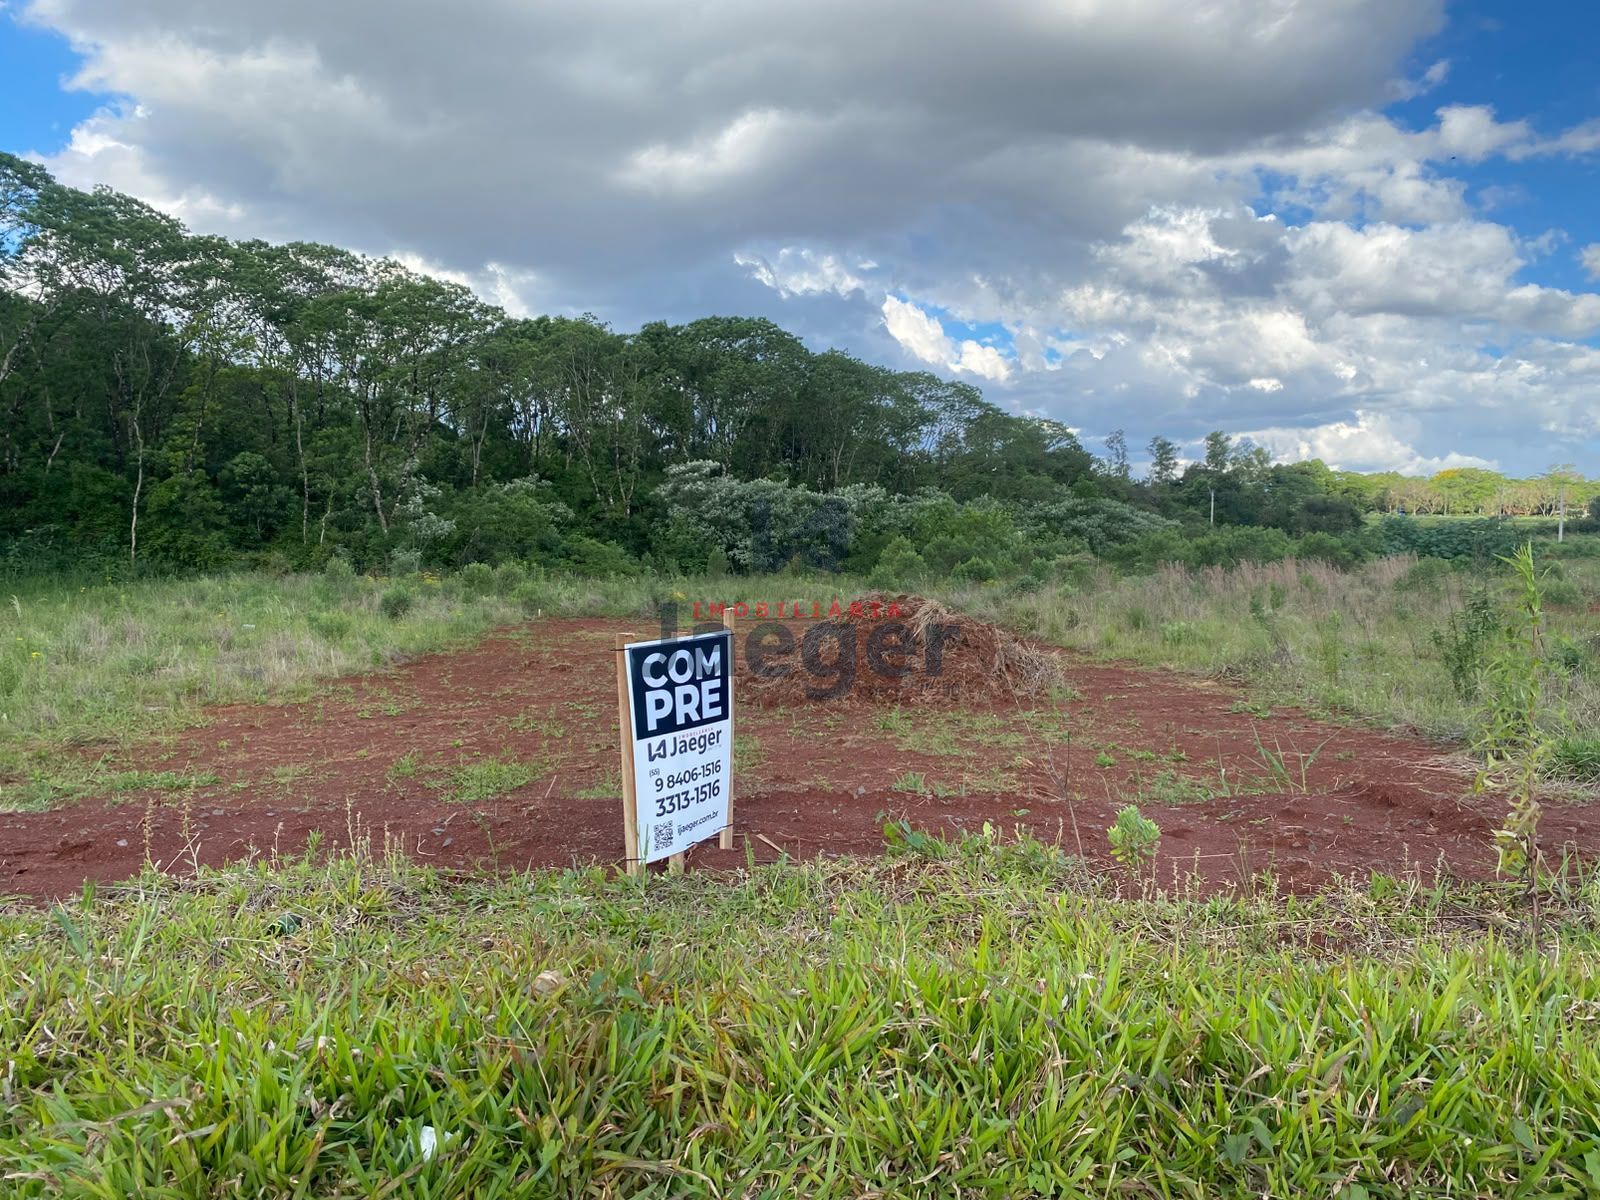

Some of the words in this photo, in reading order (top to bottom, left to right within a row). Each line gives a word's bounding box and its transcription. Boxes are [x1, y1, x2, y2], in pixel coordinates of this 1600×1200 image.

[641, 644, 721, 688] COM
[645, 678, 722, 732] PRE
[670, 729, 722, 757] Jaeger
[655, 777, 664, 793] 9
[666, 759, 722, 789] 8406-1516
[655, 779, 721, 818] 3313-1516
